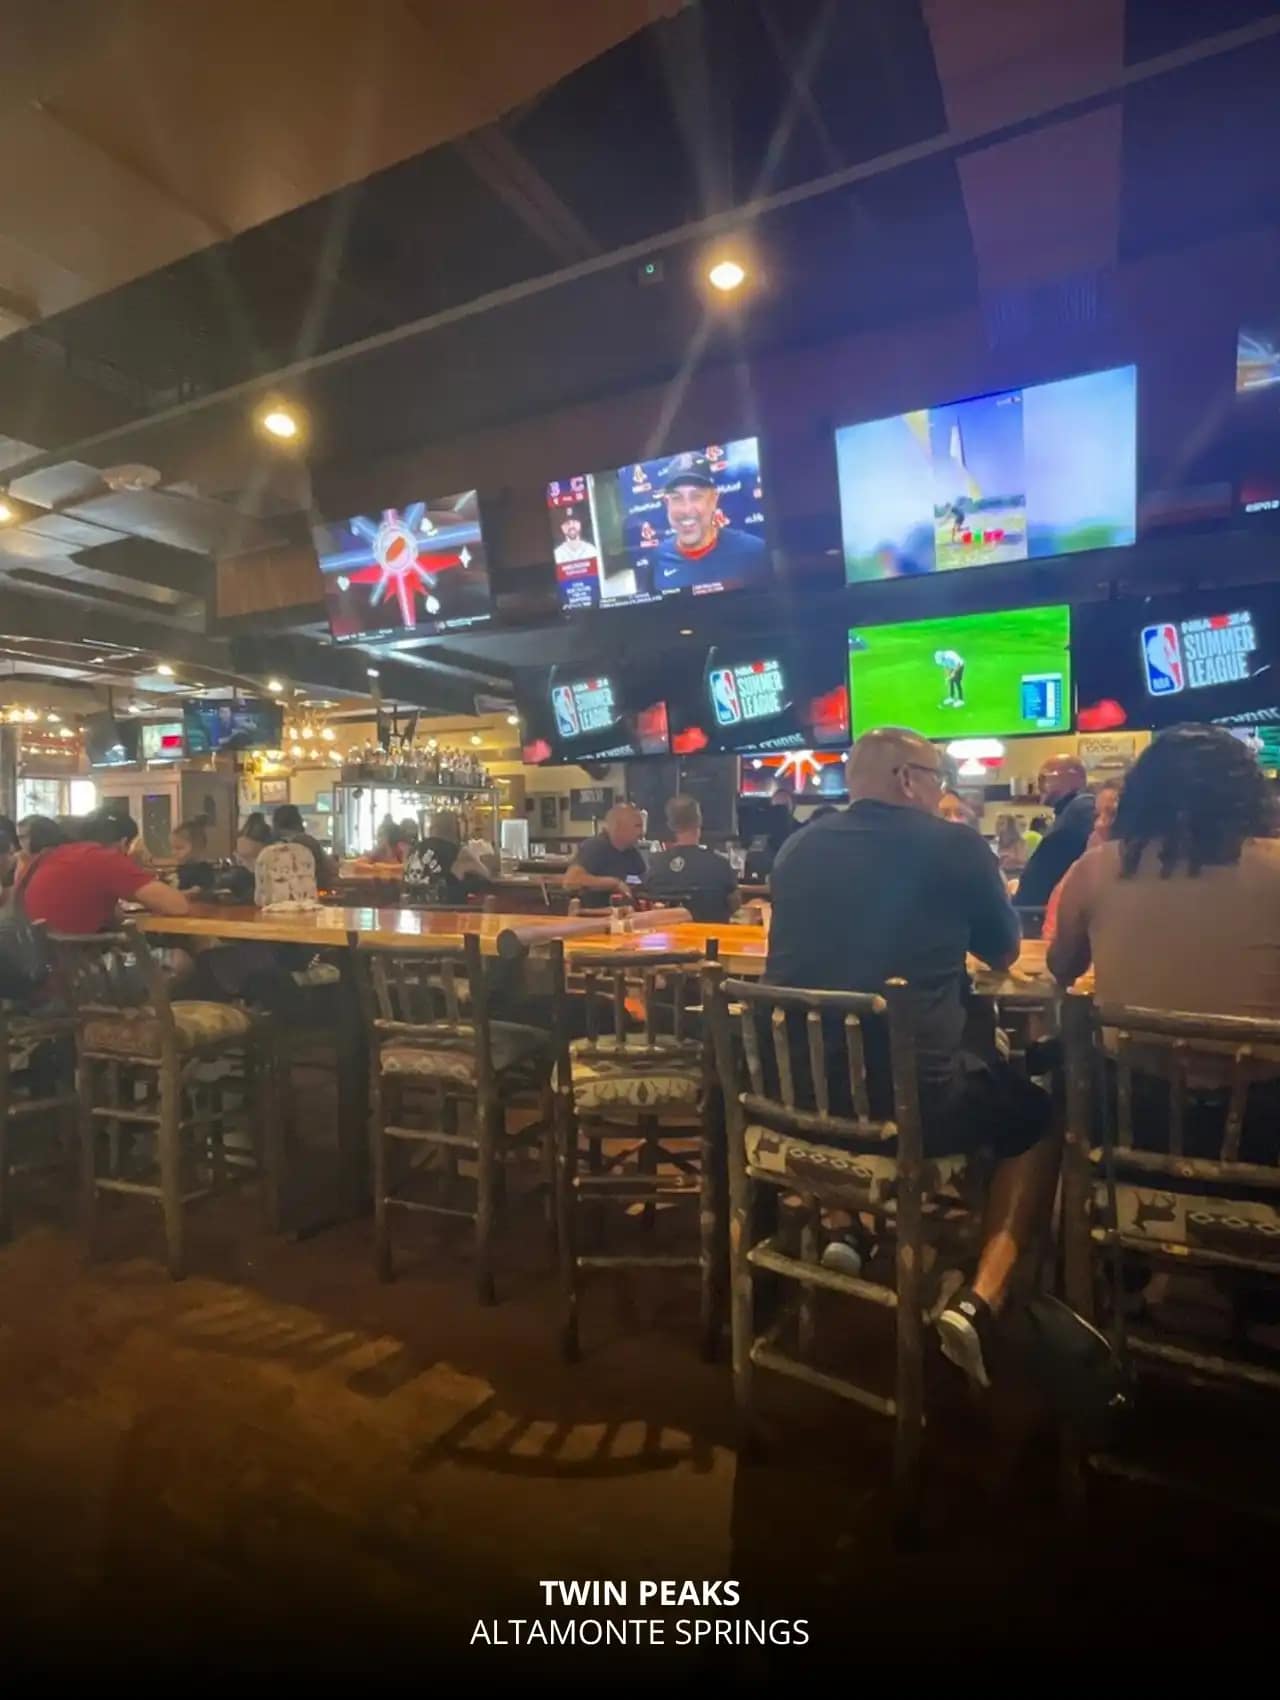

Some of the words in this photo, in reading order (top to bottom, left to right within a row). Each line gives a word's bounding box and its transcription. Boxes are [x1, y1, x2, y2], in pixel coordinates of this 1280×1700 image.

[1184, 624, 1256, 660] SUMMER
[1187, 652, 1250, 688] LEAGUE
[737, 672, 784, 698] SUMMER
[741, 692, 781, 718] LEAGUE
[579, 706, 613, 731] LEAGUE
